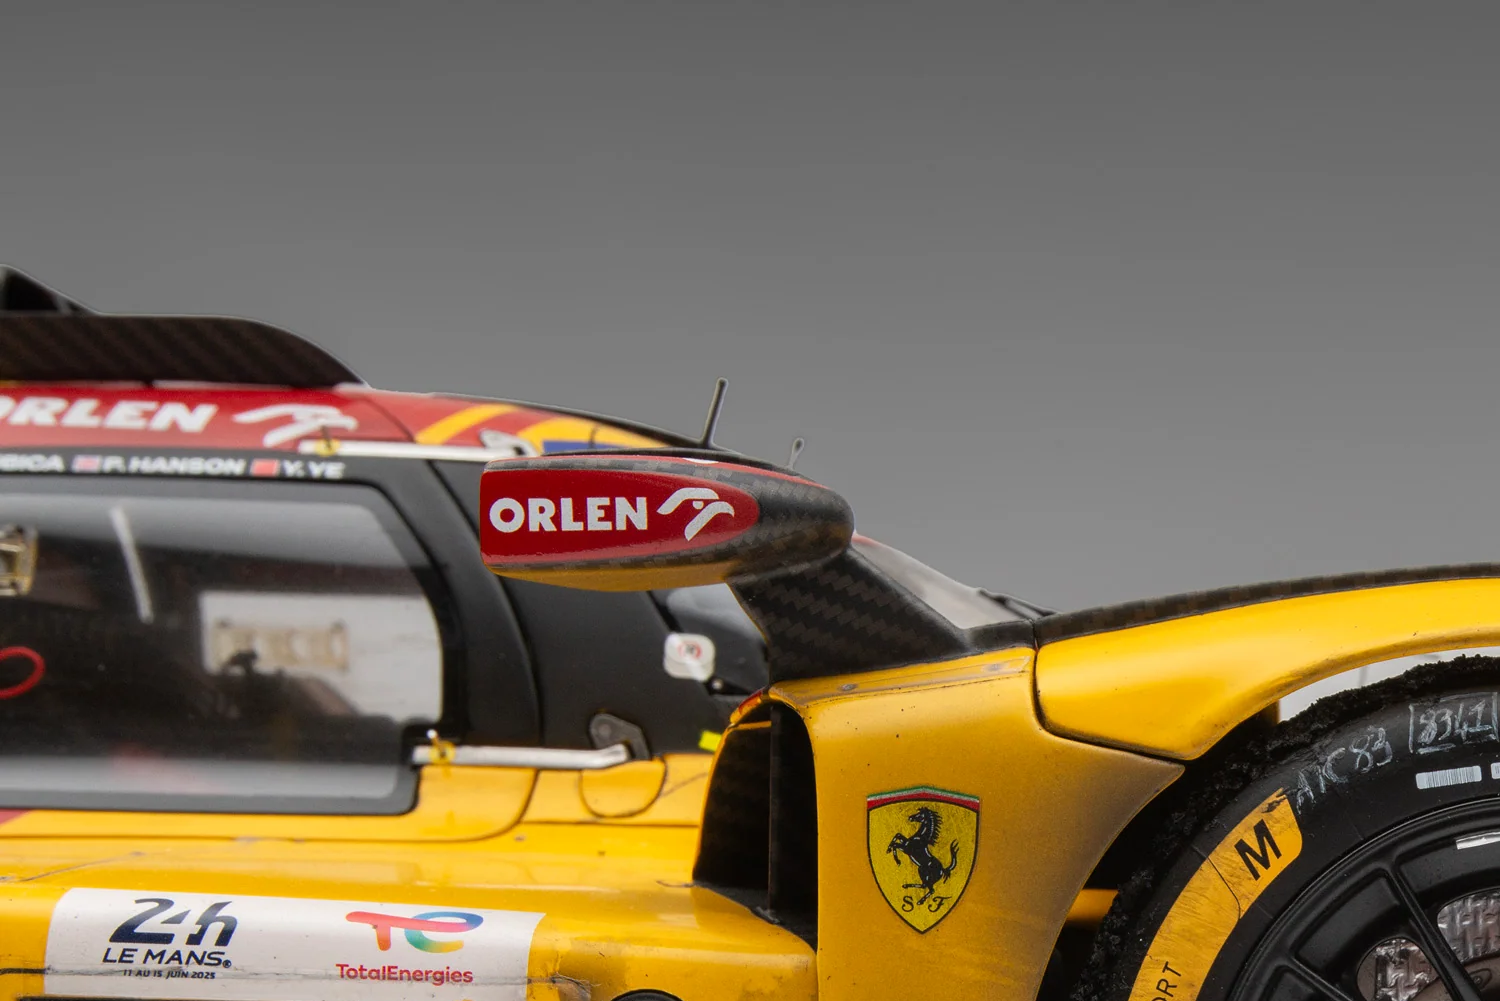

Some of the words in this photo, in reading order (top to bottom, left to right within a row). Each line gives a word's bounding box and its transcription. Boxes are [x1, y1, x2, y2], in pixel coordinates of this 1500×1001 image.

[128, 457, 247, 476] HANSON
[308, 462, 347, 480] YE
[489, 497, 648, 534] ORLEN
[1234, 819, 1283, 881] M
[901, 895, 915, 912] S
[102, 947, 138, 964] LE
[123, 969, 132, 977] 11
[135, 970, 151, 978] AU
[153, 970, 163, 978] 15
[166, 970, 190, 979] JUIN
[191, 971, 216, 980] 2025
[335, 963, 474, 986] TotalEnergies
